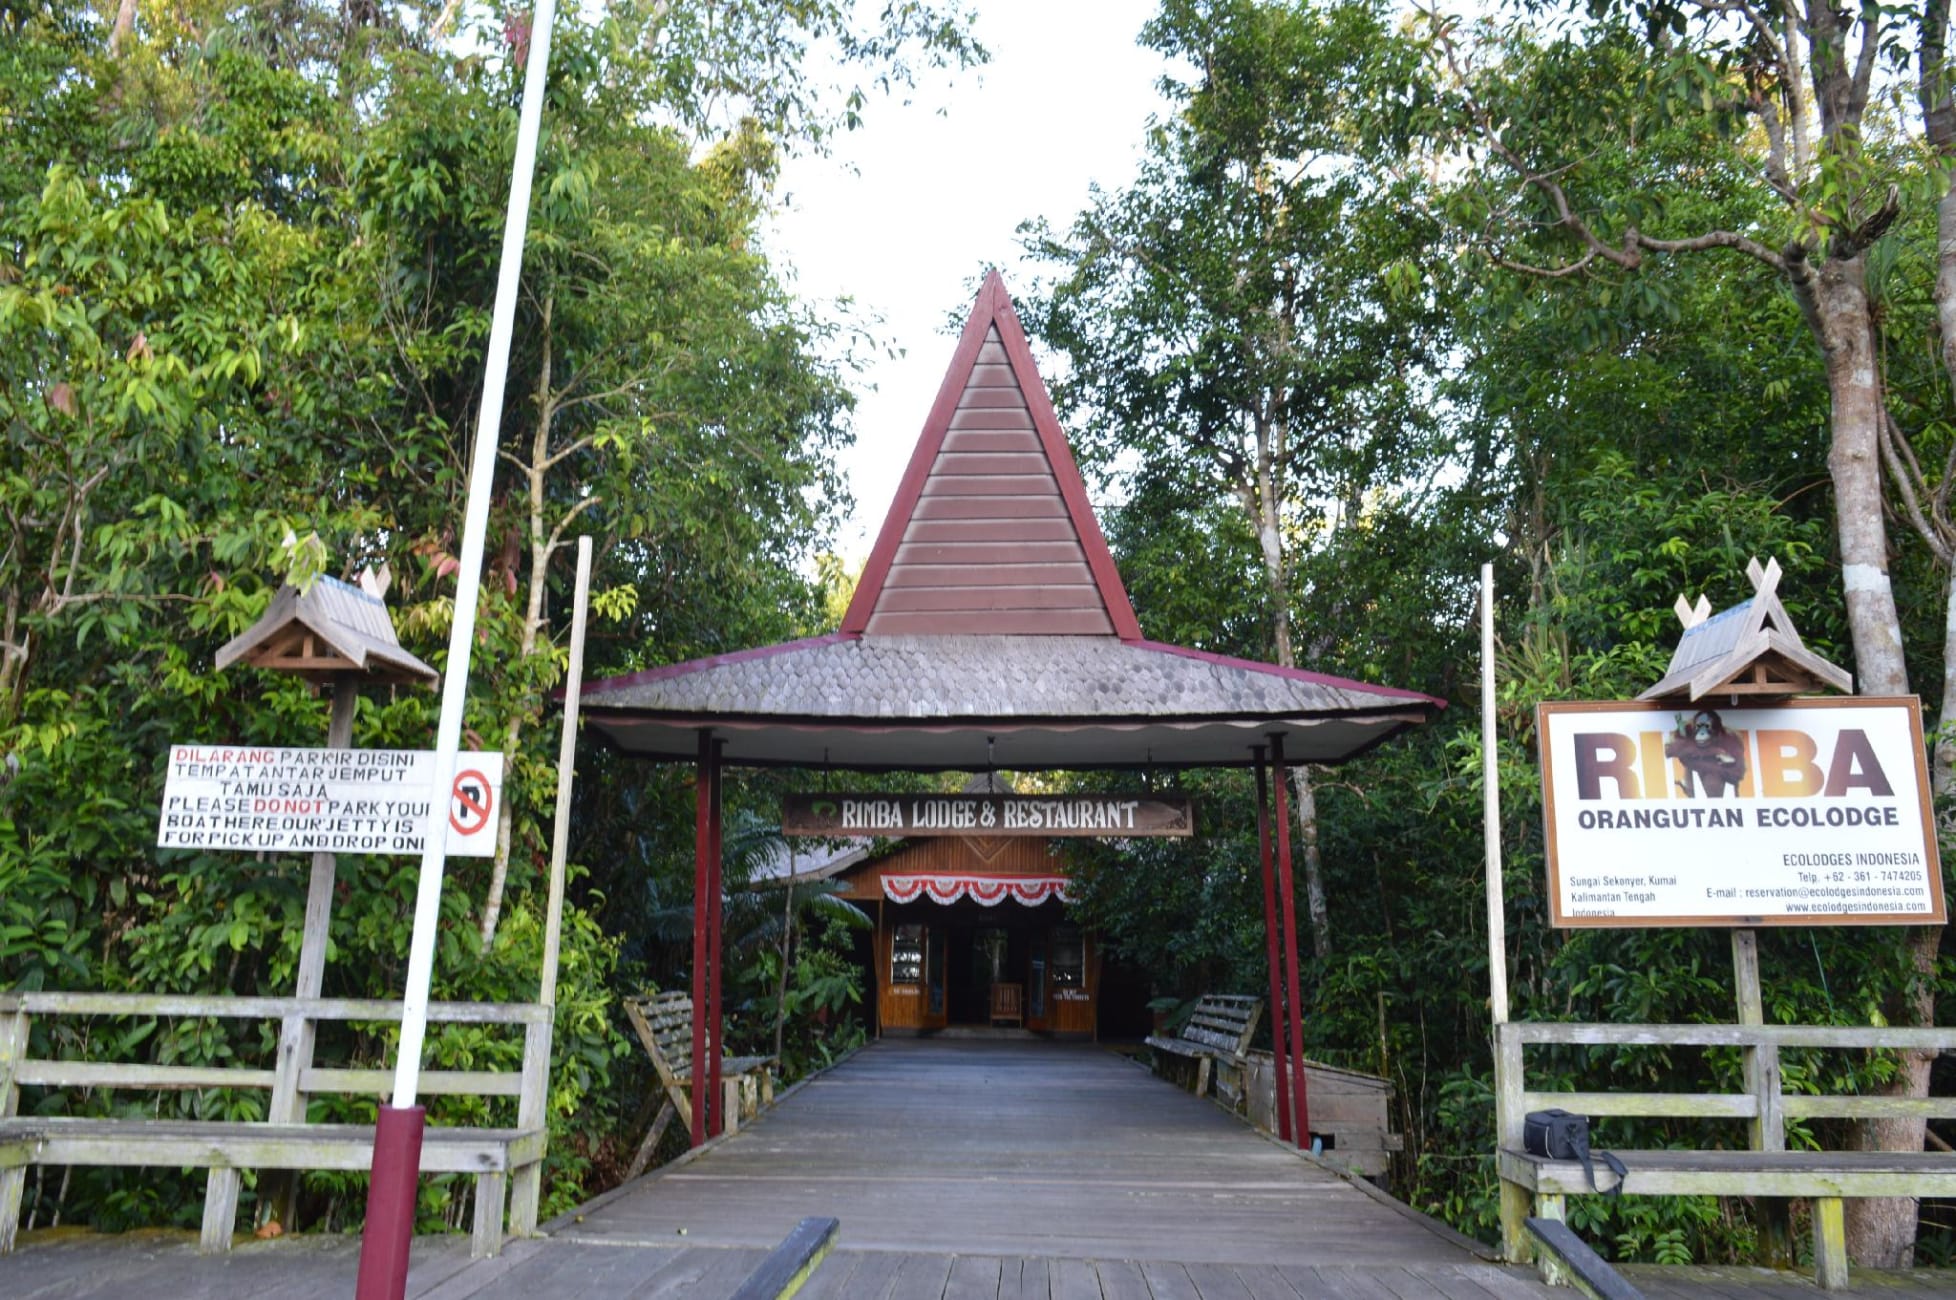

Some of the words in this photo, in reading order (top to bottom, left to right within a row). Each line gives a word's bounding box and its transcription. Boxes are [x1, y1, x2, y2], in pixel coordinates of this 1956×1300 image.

[175, 749, 275, 763] DILARANG
[280, 751, 352, 766] PARKIR
[358, 752, 415, 767] DISINI
[175, 763, 255, 778] TEMPAT
[258, 766, 325, 780] ANTAR
[328, 767, 407, 782] JEMPUT
[220, 780, 273, 797] TAMU
[278, 783, 329, 800] SAJA
[168, 796, 250, 813] PLEASE
[253, 799, 281, 814] DO
[284, 799, 324, 814] NOT
[328, 800, 380, 816] PARK
[841, 799, 904, 829] RIMBA
[911, 799, 977, 829] LODGE
[980, 800, 997, 828] &
[1003, 800, 1139, 829] RESTAURANT
[167, 814, 221, 829] BOAT
[325, 818, 391, 833] JETTY
[394, 820, 414, 834] IS
[1578, 808, 1744, 830] ORANGUTAN
[1756, 806, 1900, 828] ECOLODGE
[164, 831, 205, 845] FOR
[208, 832, 254, 846] PICK
[258, 833, 284, 847] UP
[289, 833, 329, 848] AND
[332, 834, 387, 849] DROP
[1783, 853, 1853, 867] ECOLODGES
[1855, 852, 1920, 866] INDONESIA
[1570, 876, 1601, 888] Sungai
[1648, 874, 1677, 886] Kumai
[1854, 871, 1871, 881] 361
[1881, 870, 1922, 881] 7474205
[1571, 891, 1622, 903] Kalimantan
[1624, 891, 1656, 904] Tengah
[1706, 887, 1737, 899] E-mail
[1745, 886, 1924, 899] reservation@ecolodgesindonesia.com
[1785, 901, 1926, 914] www.ecolodgesindonesia.com
